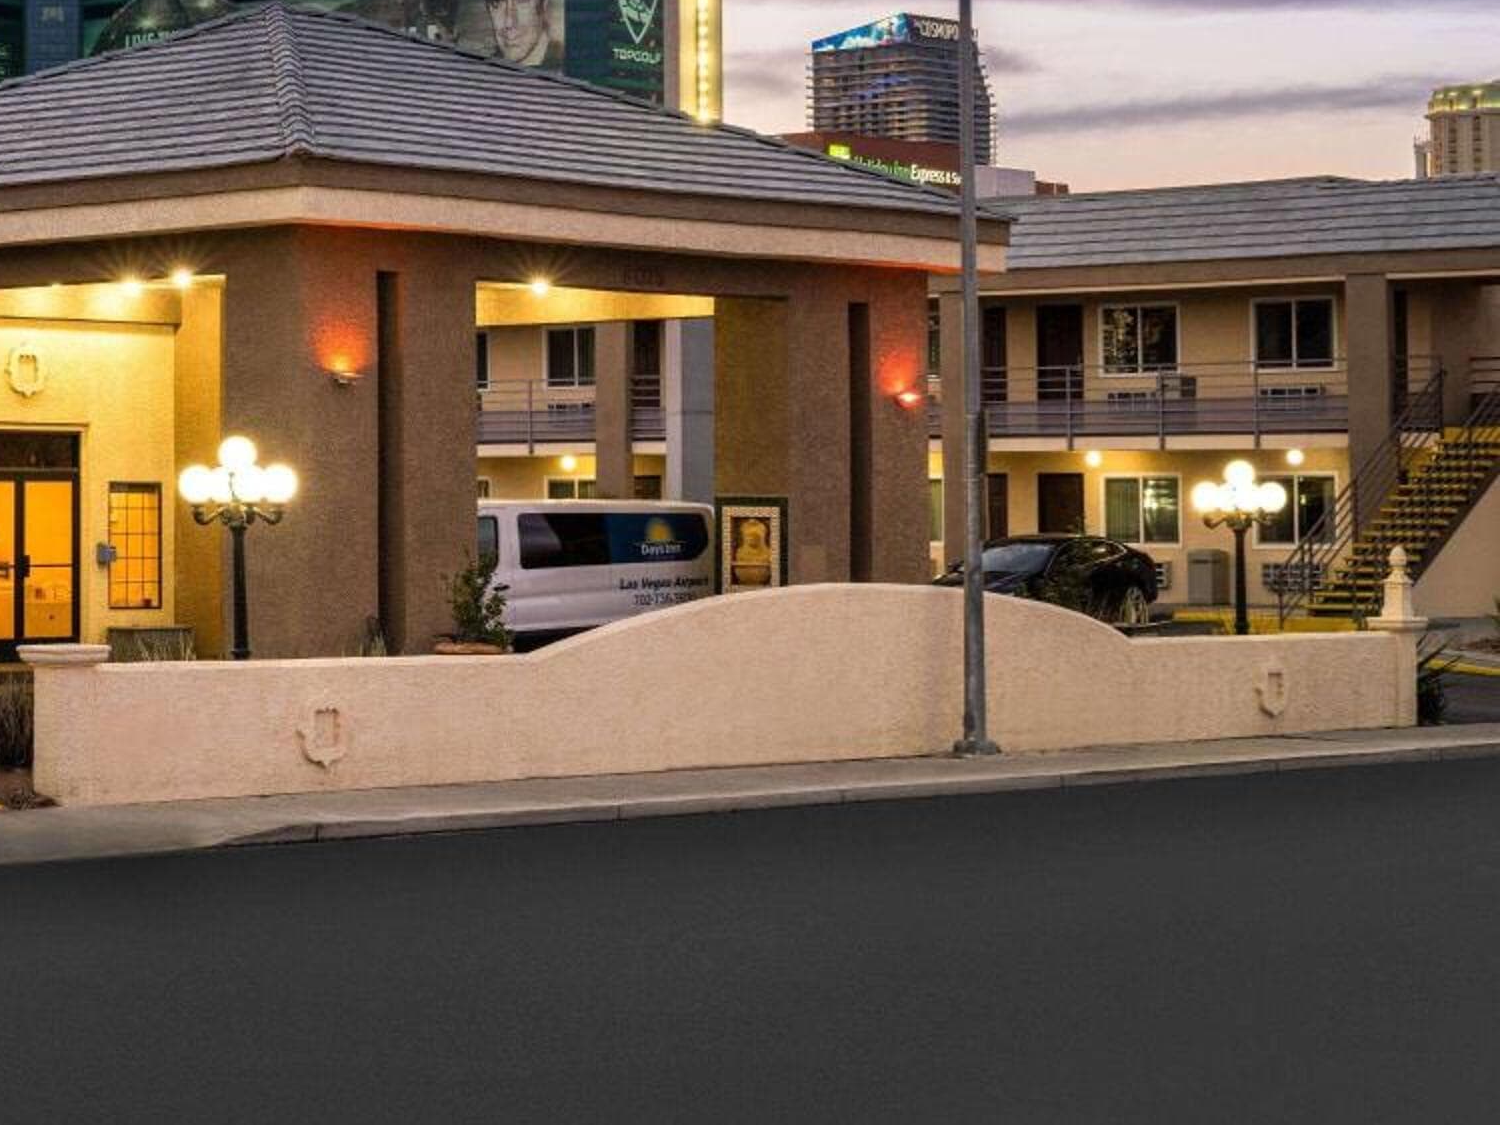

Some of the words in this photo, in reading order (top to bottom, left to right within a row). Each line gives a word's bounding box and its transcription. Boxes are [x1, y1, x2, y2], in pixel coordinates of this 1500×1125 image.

[910, 163, 945, 185] Express
[620, 577, 639, 590] Las
[642, 576, 672, 591] Vegas
